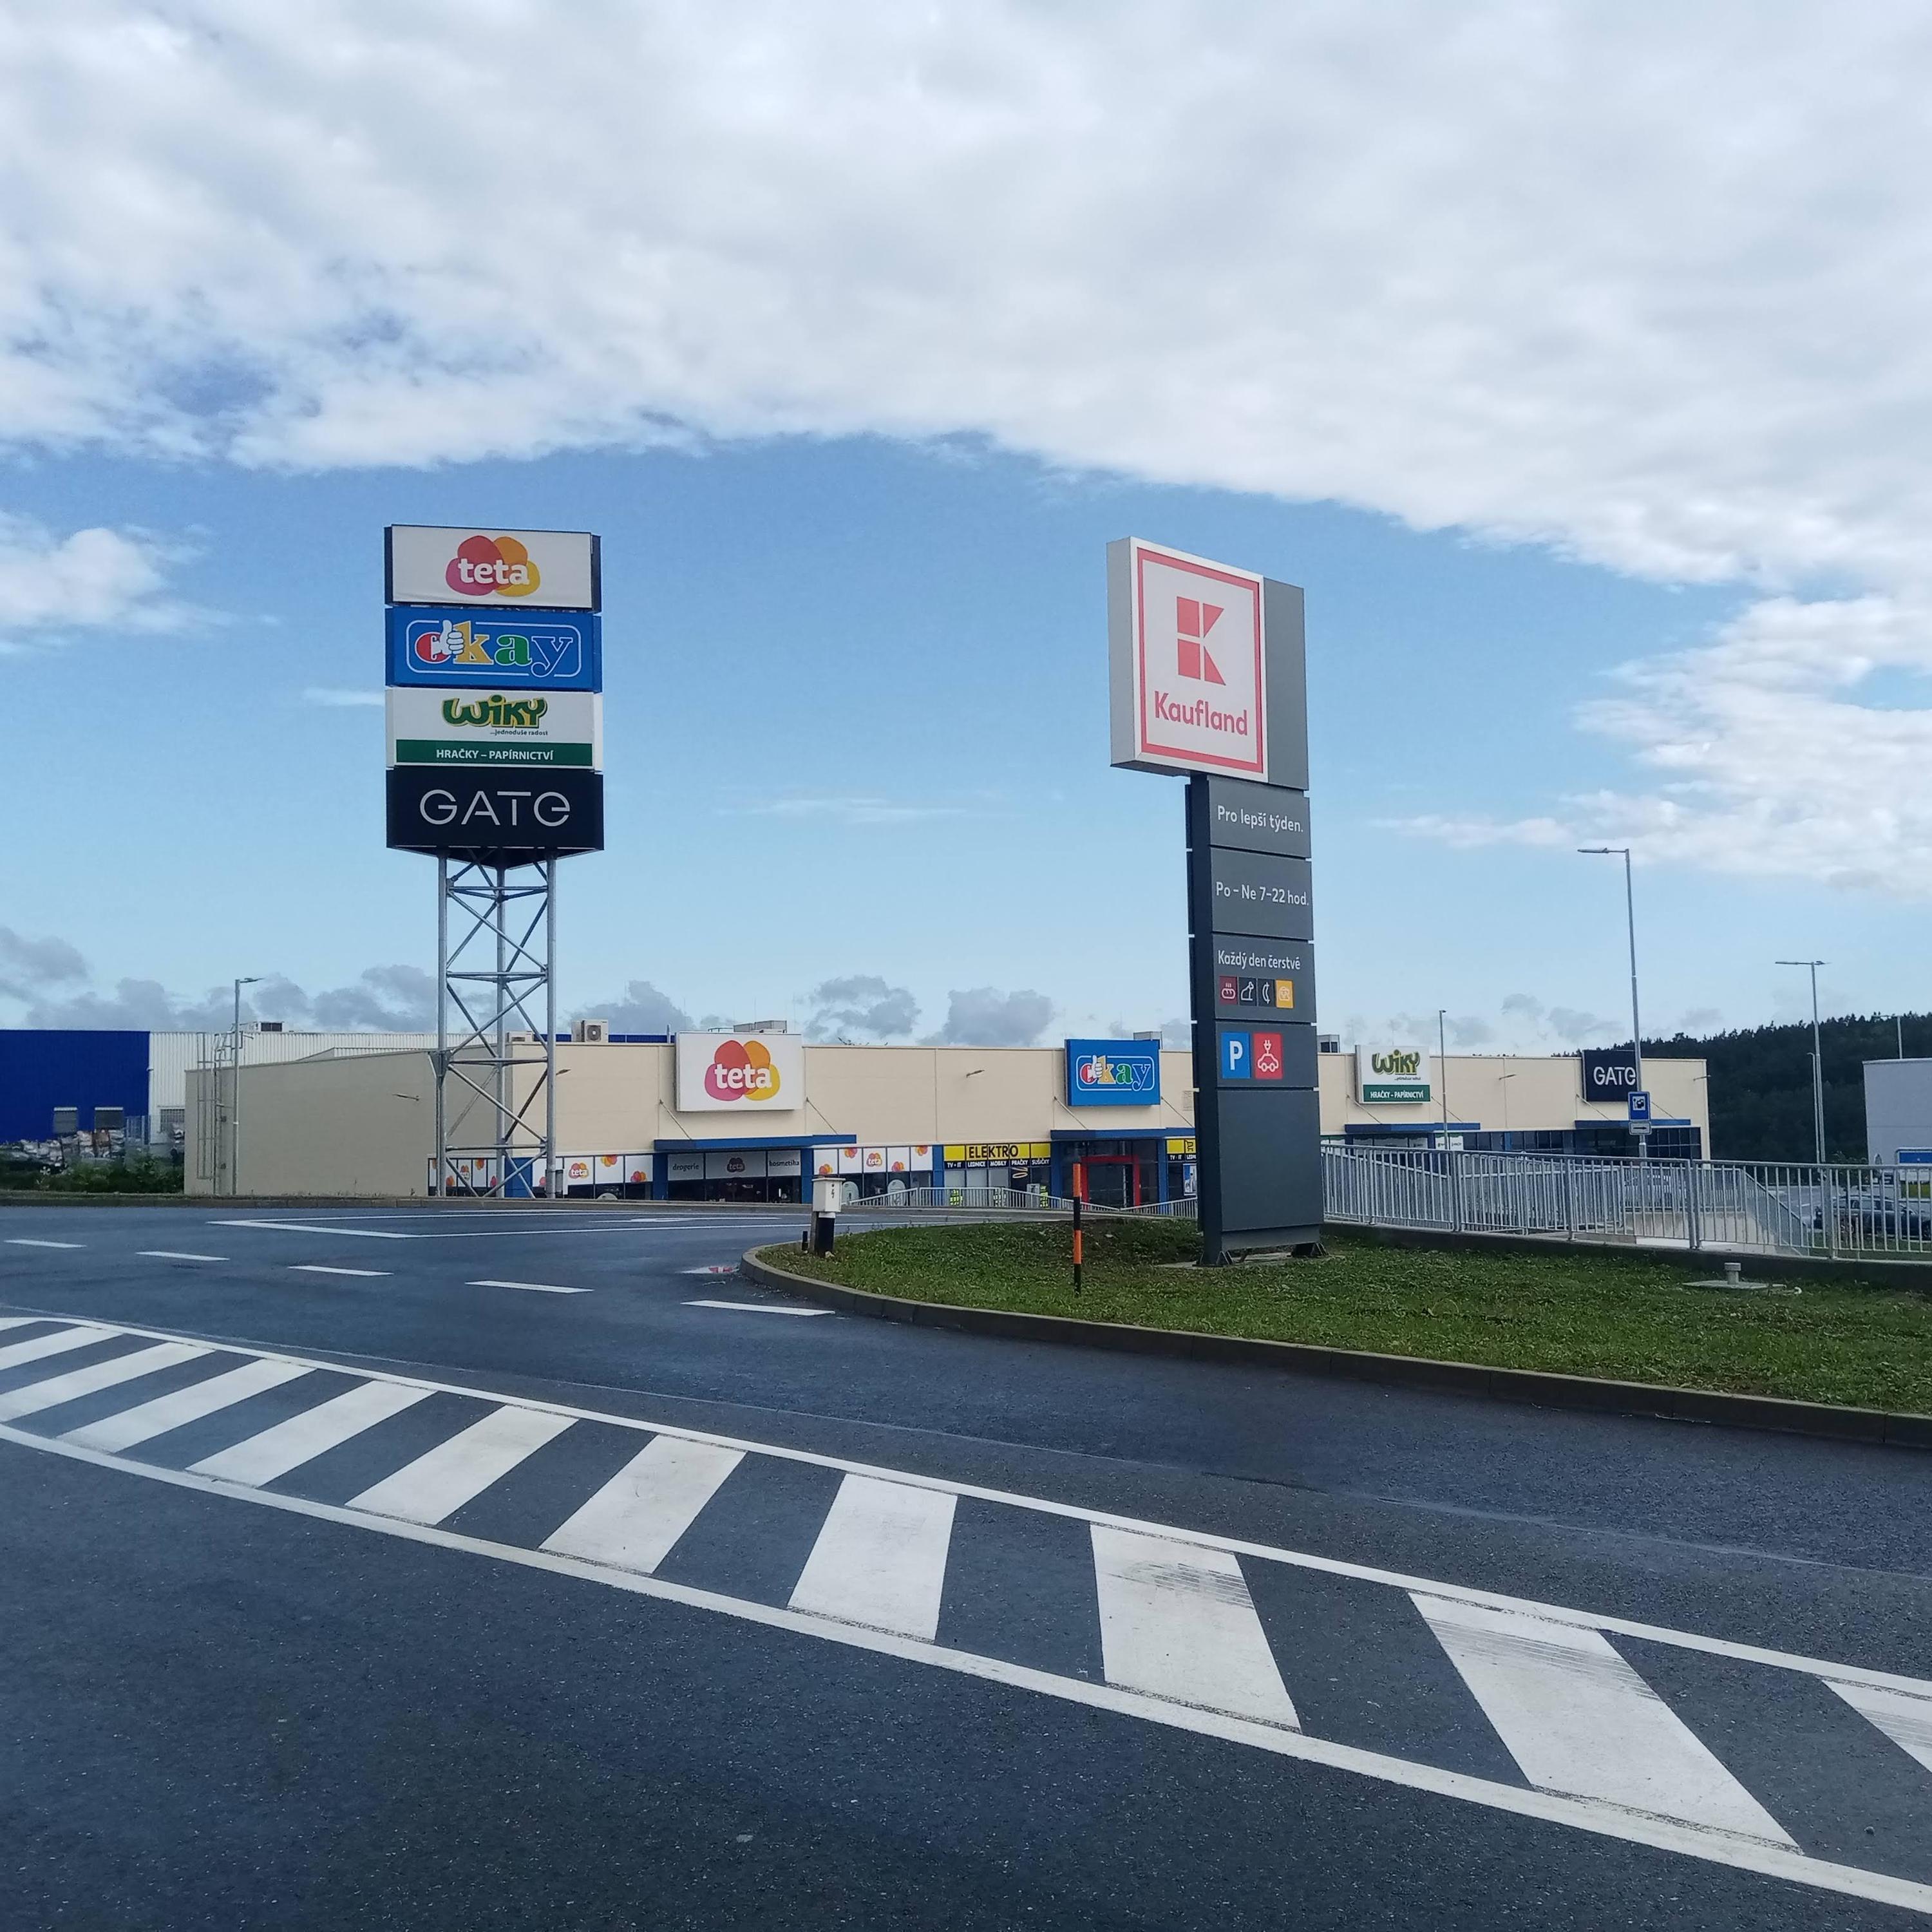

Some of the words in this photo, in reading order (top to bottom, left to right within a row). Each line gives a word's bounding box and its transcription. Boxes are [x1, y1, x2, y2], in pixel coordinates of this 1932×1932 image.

[458, 558, 530, 585] teta
[1155, 690, 1248, 736] Kaufland
[436, 748, 478, 759] HRAČKY
[489, 749, 554, 761] PAPÍRNICTVÍ
[1217, 805, 1237, 823] Pro
[1240, 808, 1267, 828] lepší
[1268, 811, 1304, 833] týden.
[1216, 881, 1231, 898] Po
[1242, 884, 1256, 901] Ne
[1288, 891, 1309, 906] hod.
[1218, 949, 1247, 969] Každý
[1249, 951, 1266, 968] den
[1268, 954, 1301, 971] čerstvé
[1229, 1040, 1244, 1070] P
[715, 1063, 772, 1089] teta
[969, 1144, 1019, 1159] ELEKTRO
[672, 1163, 699, 1171] drogerie
